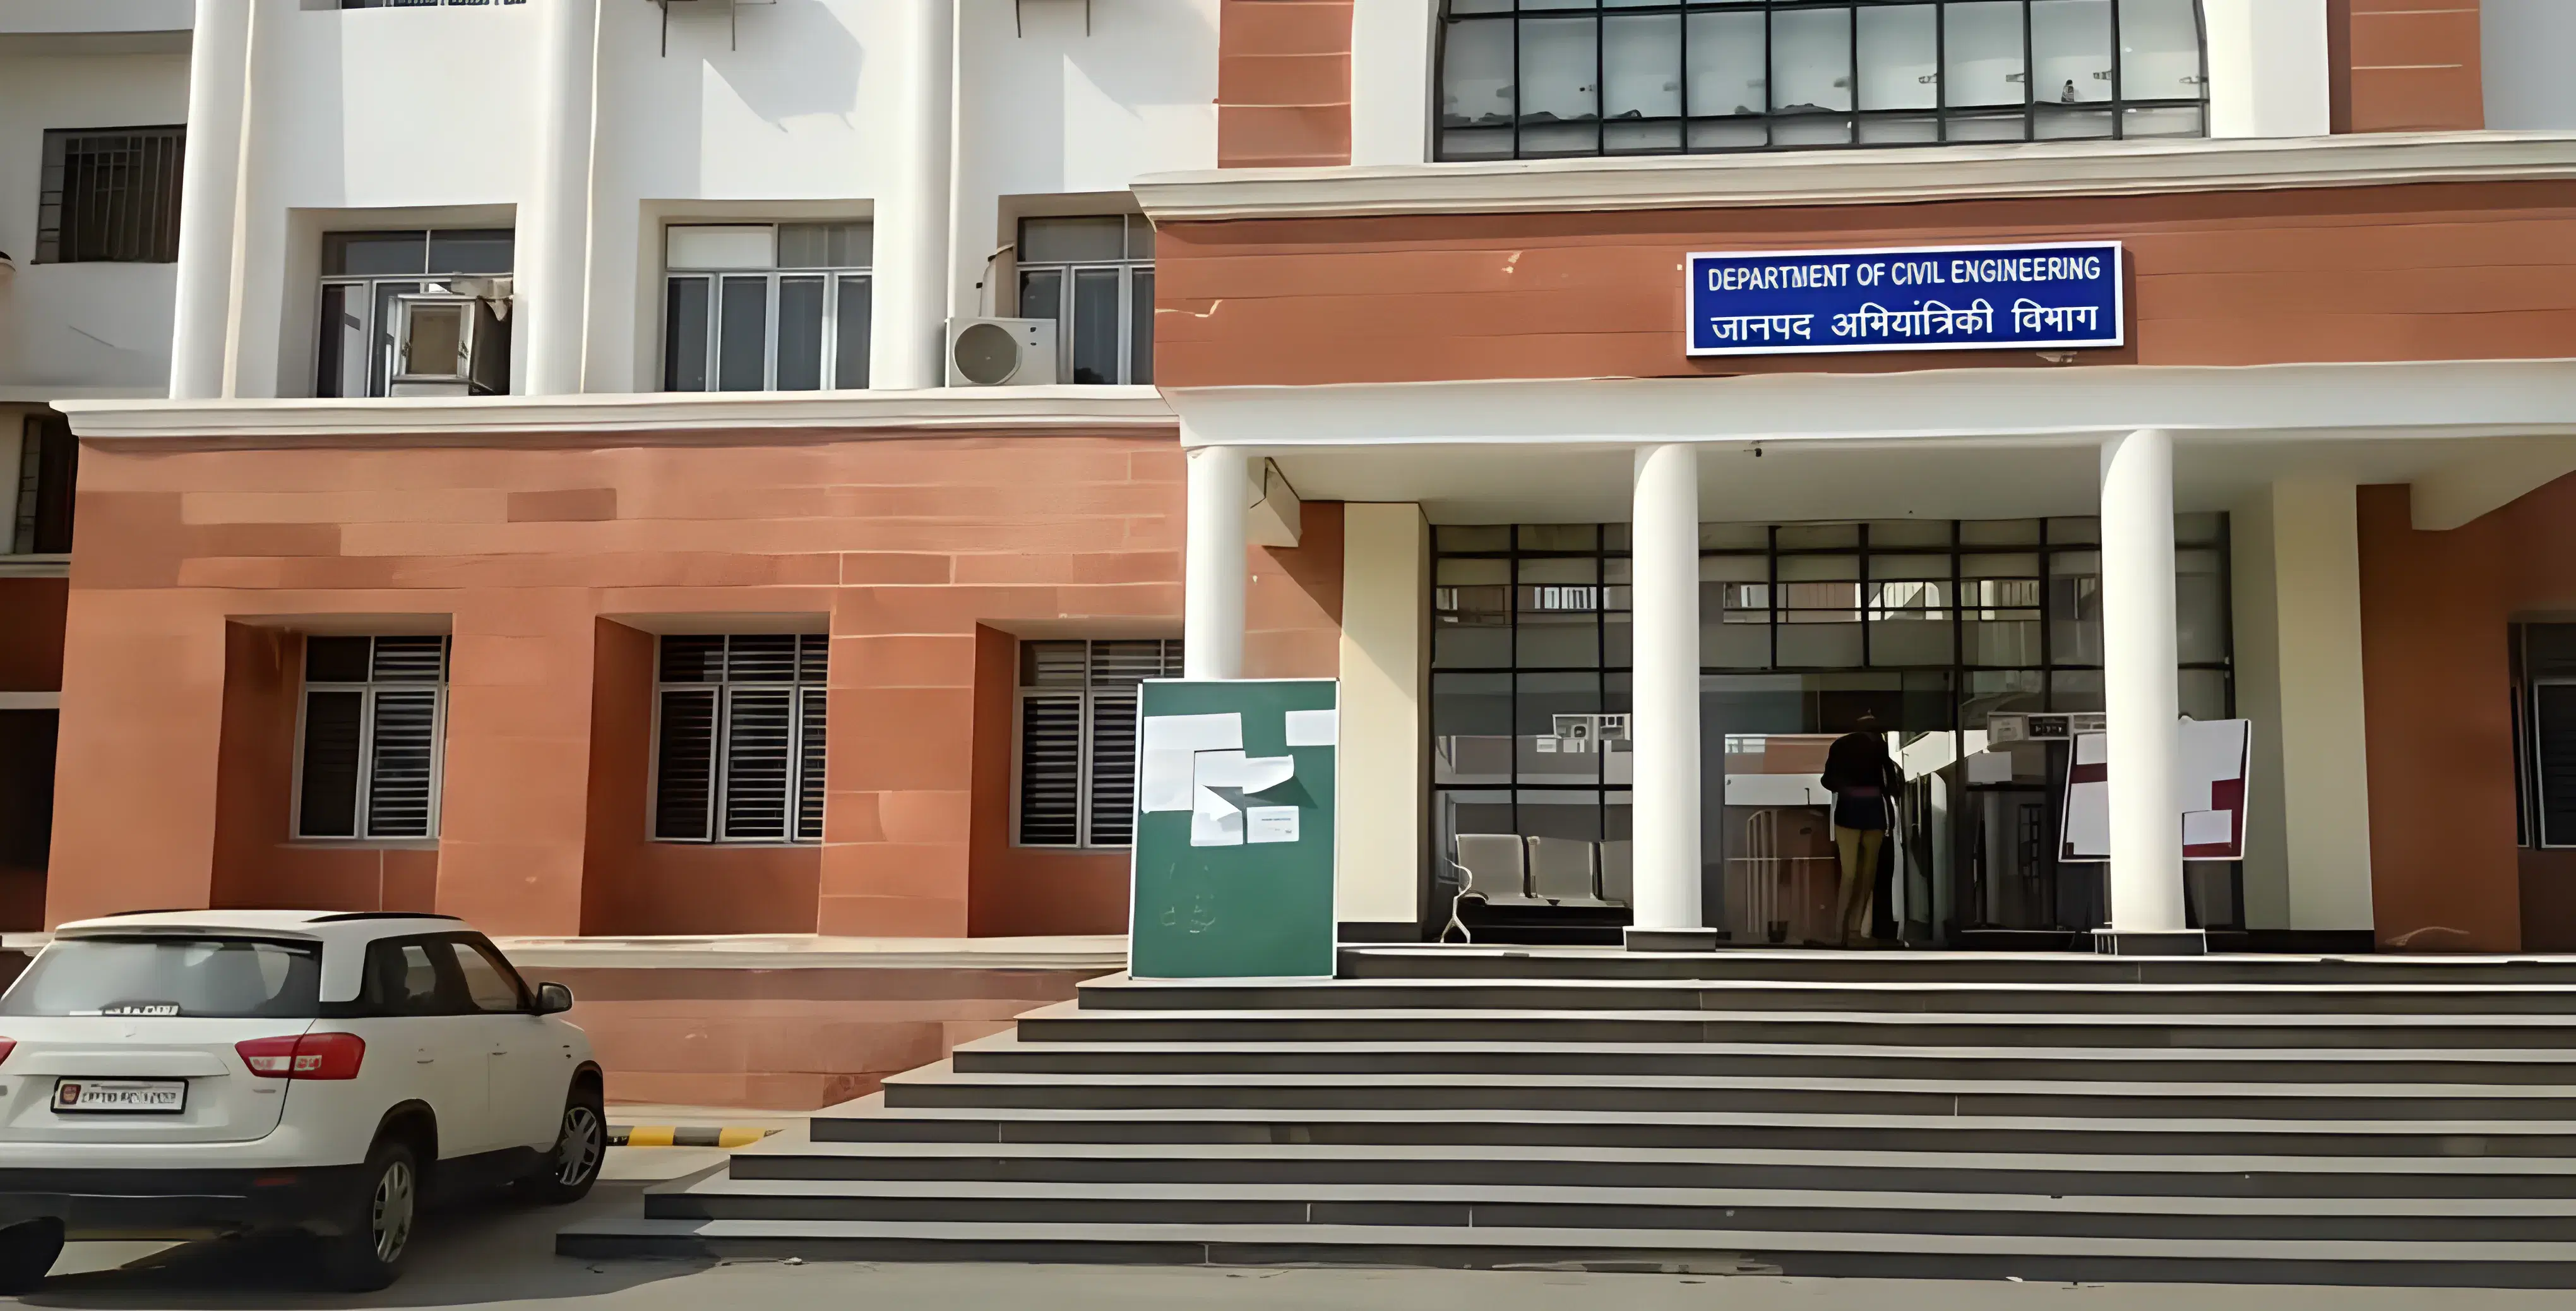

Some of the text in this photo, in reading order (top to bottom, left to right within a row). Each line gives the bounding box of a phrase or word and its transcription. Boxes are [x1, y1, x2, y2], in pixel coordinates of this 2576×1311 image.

[1857, 263, 1886, 286] OF
[1891, 260, 1945, 285] CIVIL
[1951, 255, 2101, 284] ENGINEERING
[1710, 297, 2099, 341] जानपद अभियांत्रिकी विभाग
